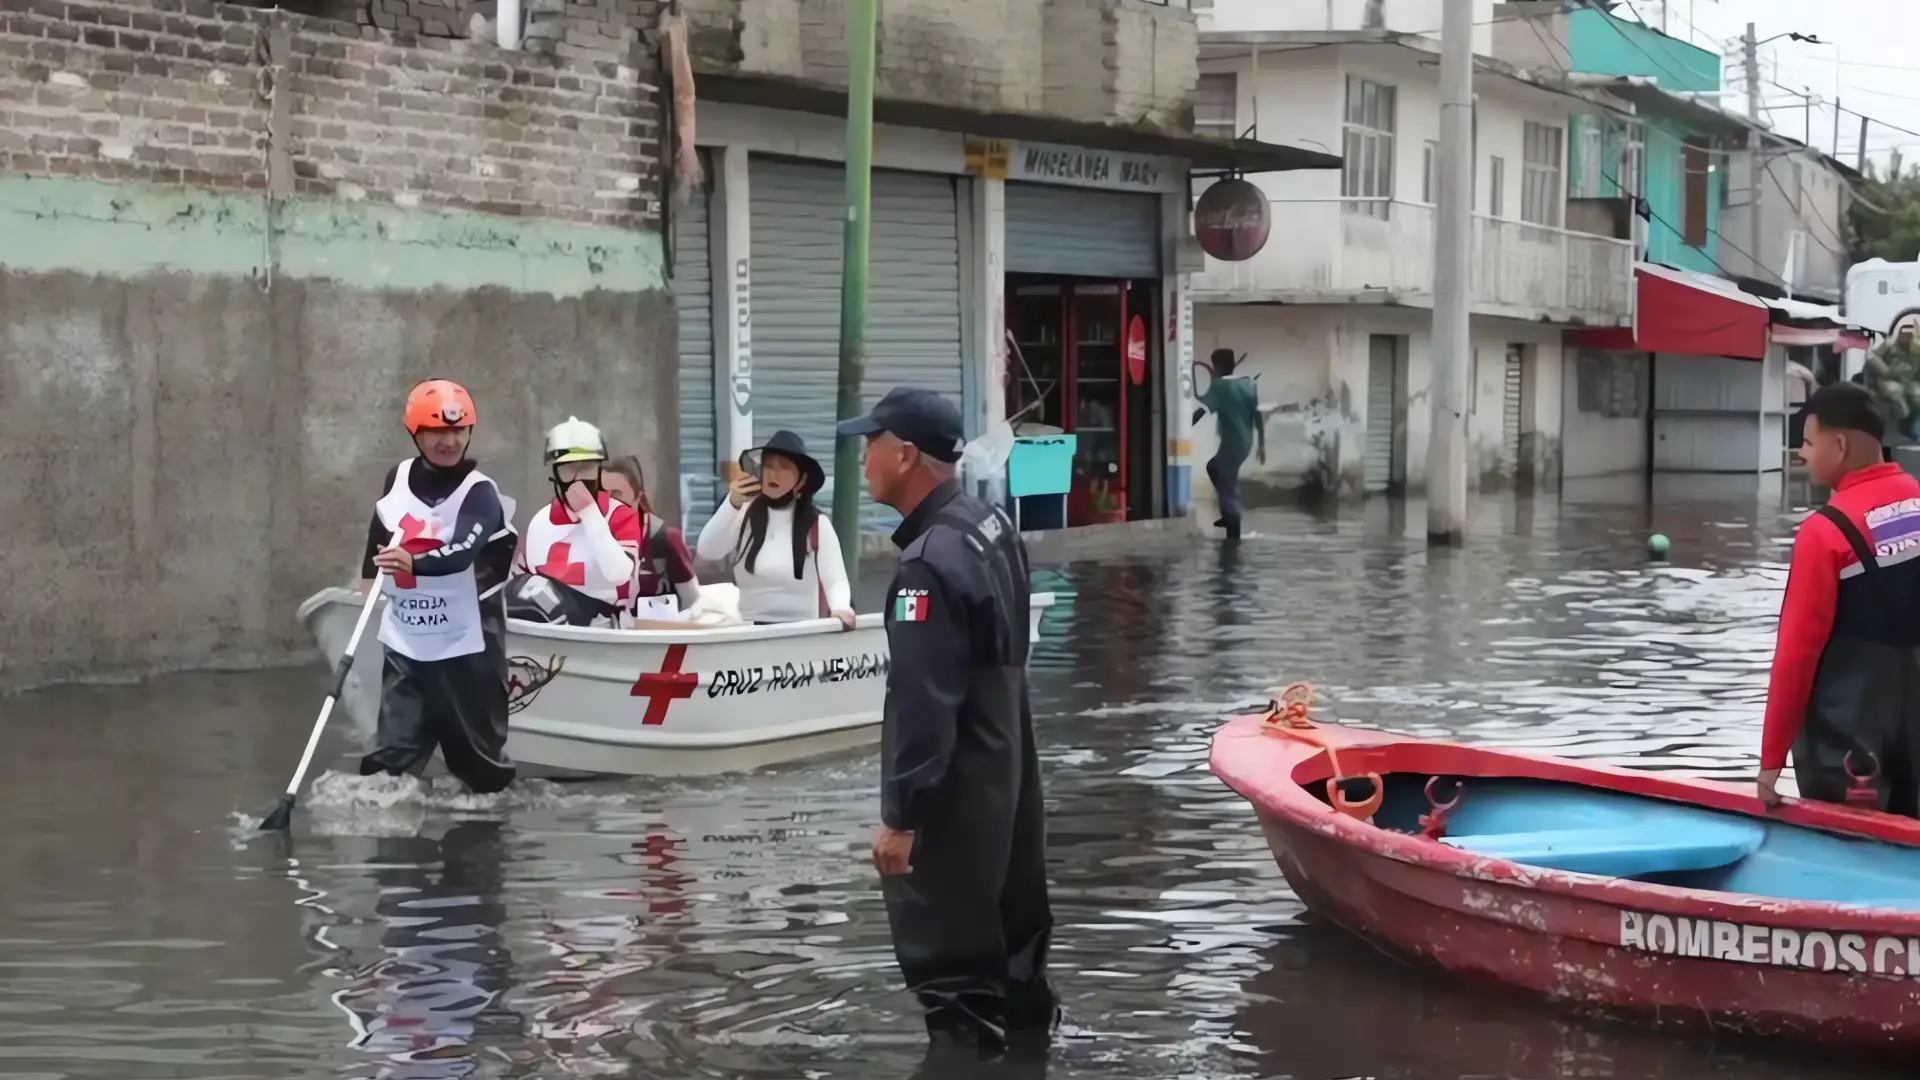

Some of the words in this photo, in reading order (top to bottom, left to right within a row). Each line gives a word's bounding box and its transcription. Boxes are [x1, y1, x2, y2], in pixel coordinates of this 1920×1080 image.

[707, 667, 763, 699] CRUZ
[766, 661, 814, 692] ROJA
[819, 652, 891, 683] MEXICAN
[1620, 909, 1867, 974] BOMBEROS
